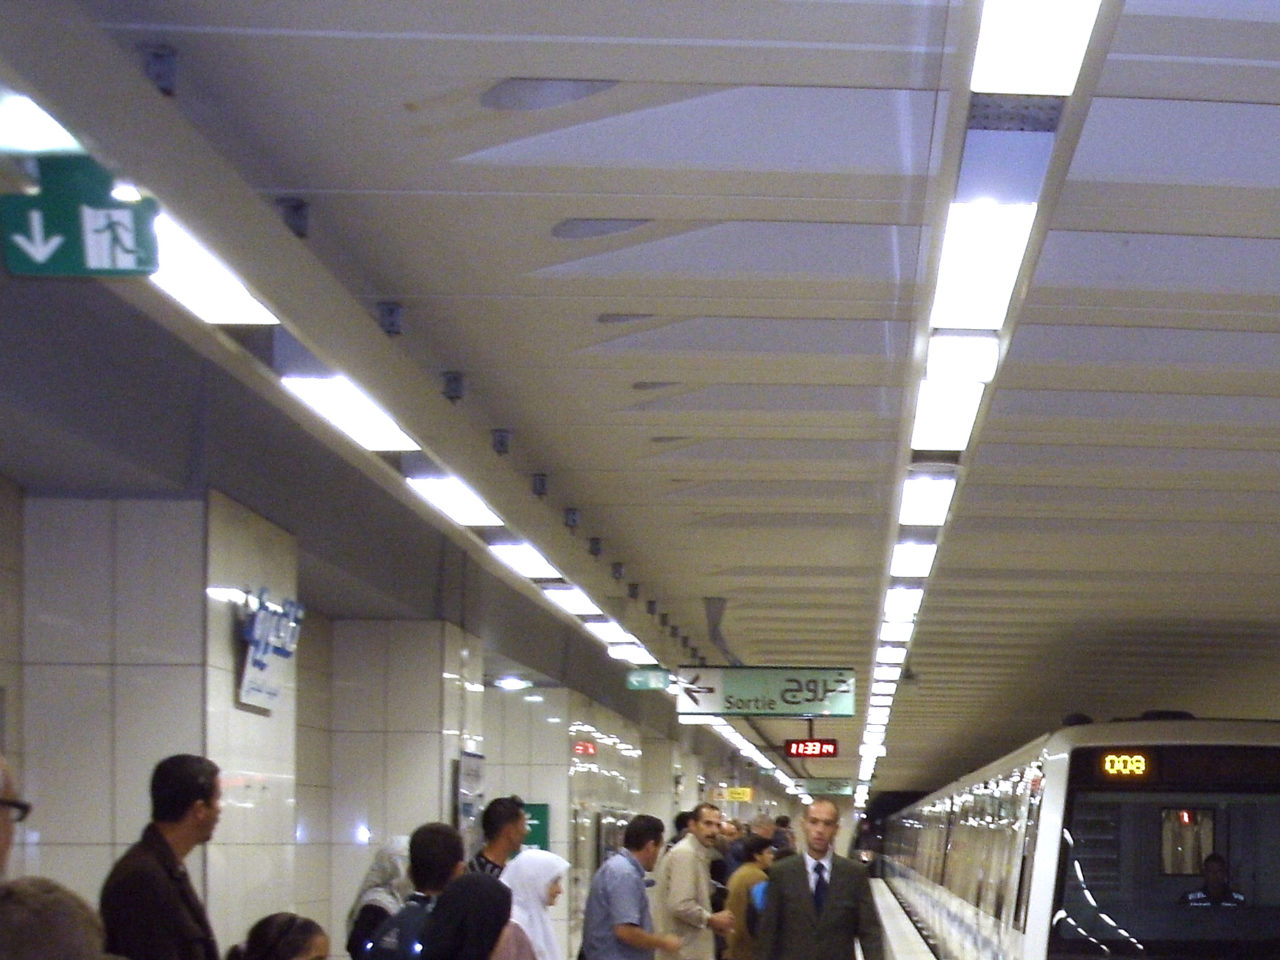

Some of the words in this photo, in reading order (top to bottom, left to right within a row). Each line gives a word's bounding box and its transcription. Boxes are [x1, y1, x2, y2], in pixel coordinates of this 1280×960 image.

[780, 672, 850, 705] خروج
[724, 696, 776, 711] Sortie
[1104, 755, 1146, 774] 008
